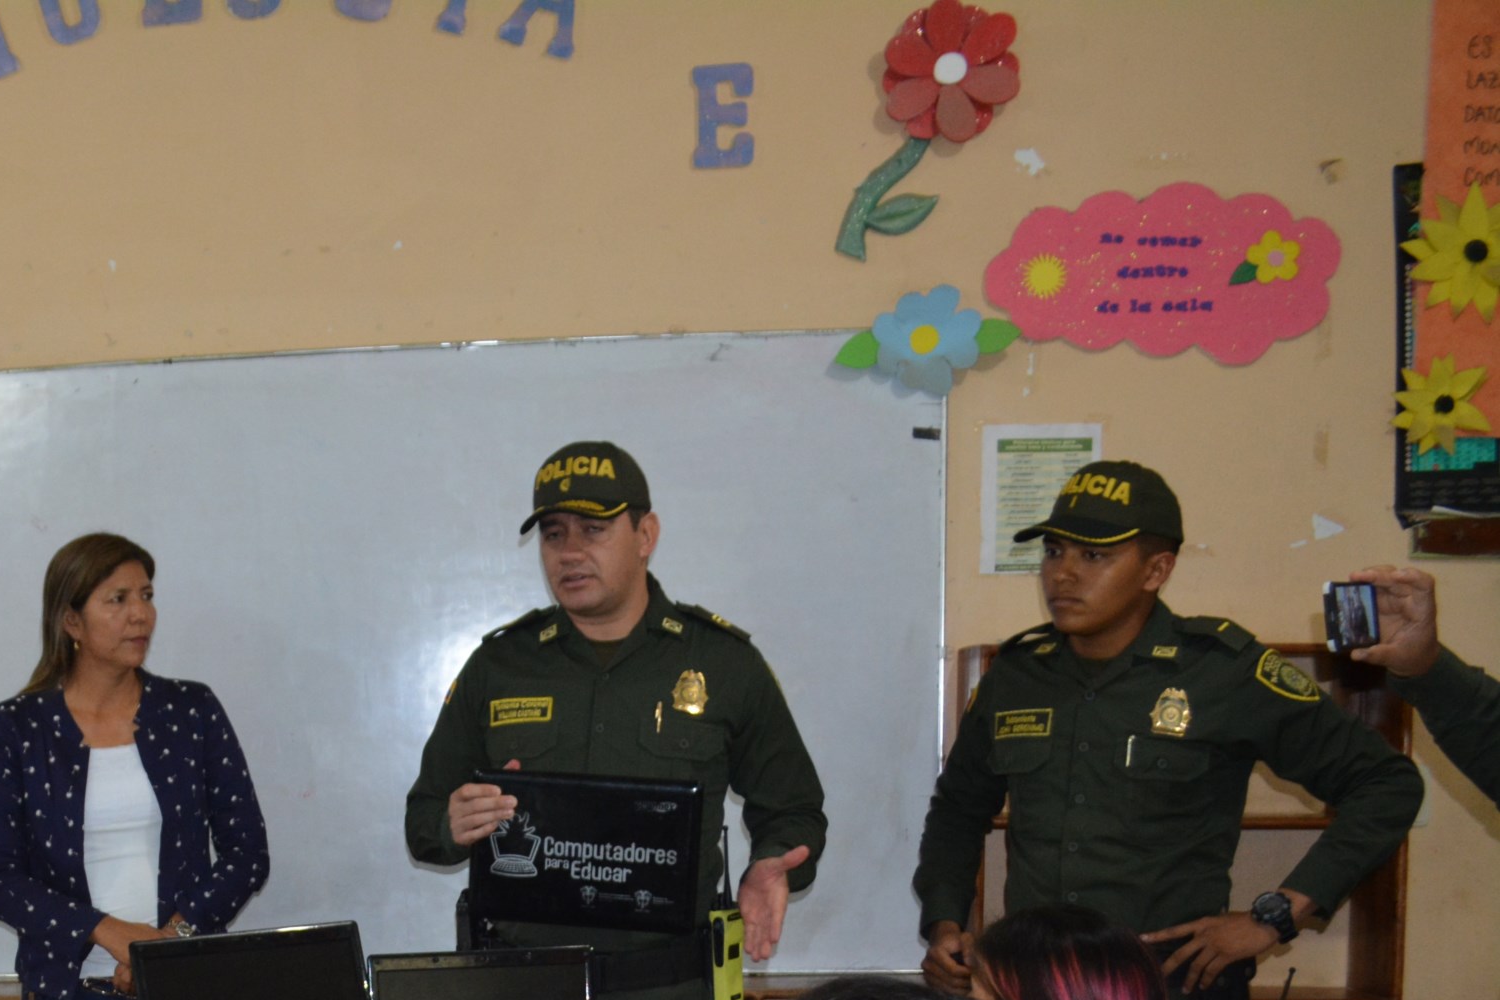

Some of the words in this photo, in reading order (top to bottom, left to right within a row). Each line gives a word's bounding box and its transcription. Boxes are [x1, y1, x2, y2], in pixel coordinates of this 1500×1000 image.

[691, 62, 754, 171] E
[1117, 265, 1188, 278] dentro
[1061, 473, 1131, 505] LICIA
[543, 836, 677, 865] Computadores
[544, 857, 569, 870] para
[570, 860, 632, 882] Educar
